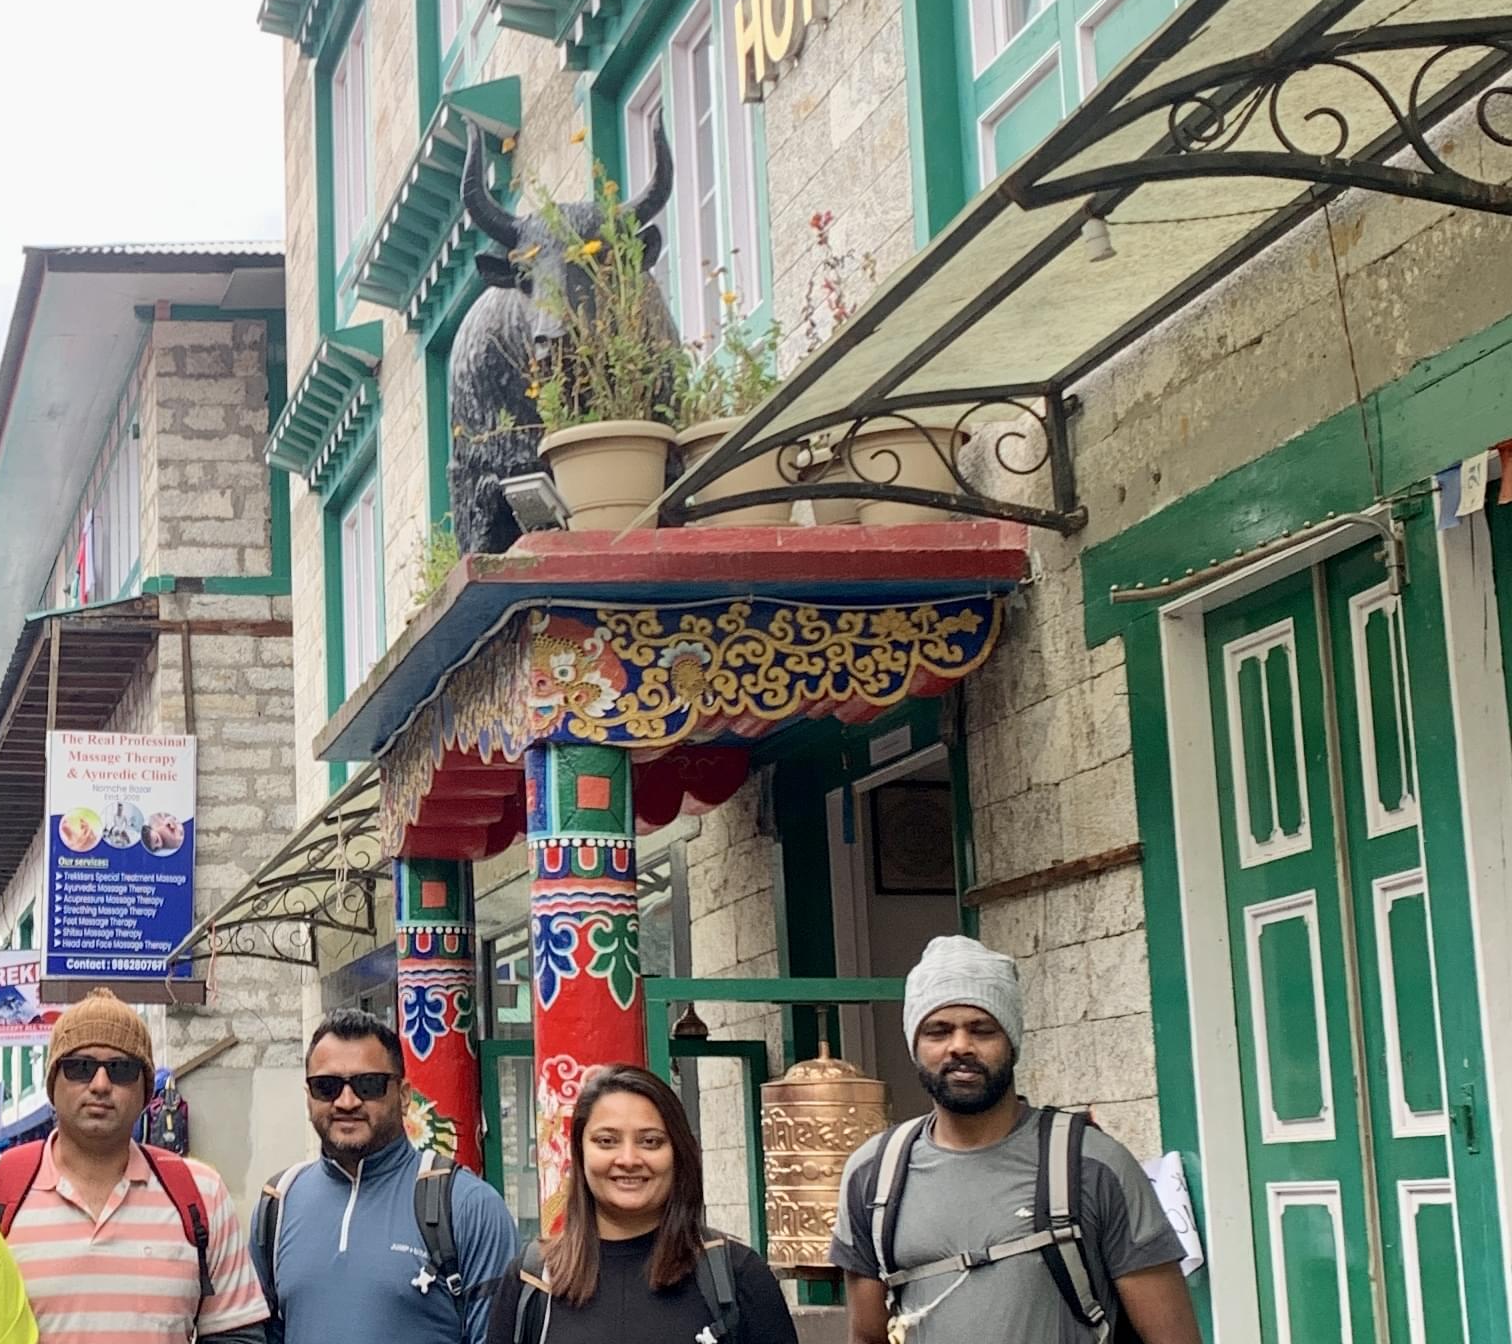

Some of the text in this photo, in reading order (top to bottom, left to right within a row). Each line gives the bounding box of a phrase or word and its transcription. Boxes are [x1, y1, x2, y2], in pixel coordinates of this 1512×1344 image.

[62, 733, 186, 748] The Real Professinal
[69, 751, 177, 767] Massage Therapy
[67, 768, 78, 779] &
[142, 769, 178, 781] Clinic
[58, 856, 73, 866] Our
[156, 874, 186, 886] Massage
[98, 884, 128, 895] Massage
[129, 884, 157, 896] Therapy
[106, 895, 136, 906] Massage
[137, 896, 165, 907] Therapy
[98, 906, 129, 918] Massage
[130, 907, 157, 919] Therapy
[79, 918, 109, 928] Massage
[110, 918, 138, 929] Therapy
[84, 929, 114, 940] Massage
[115, 929, 143, 941] Therapy
[113, 940, 144, 952] Massage
[144, 941, 172, 952] Therapy
[66, 959, 106, 970] Contact
